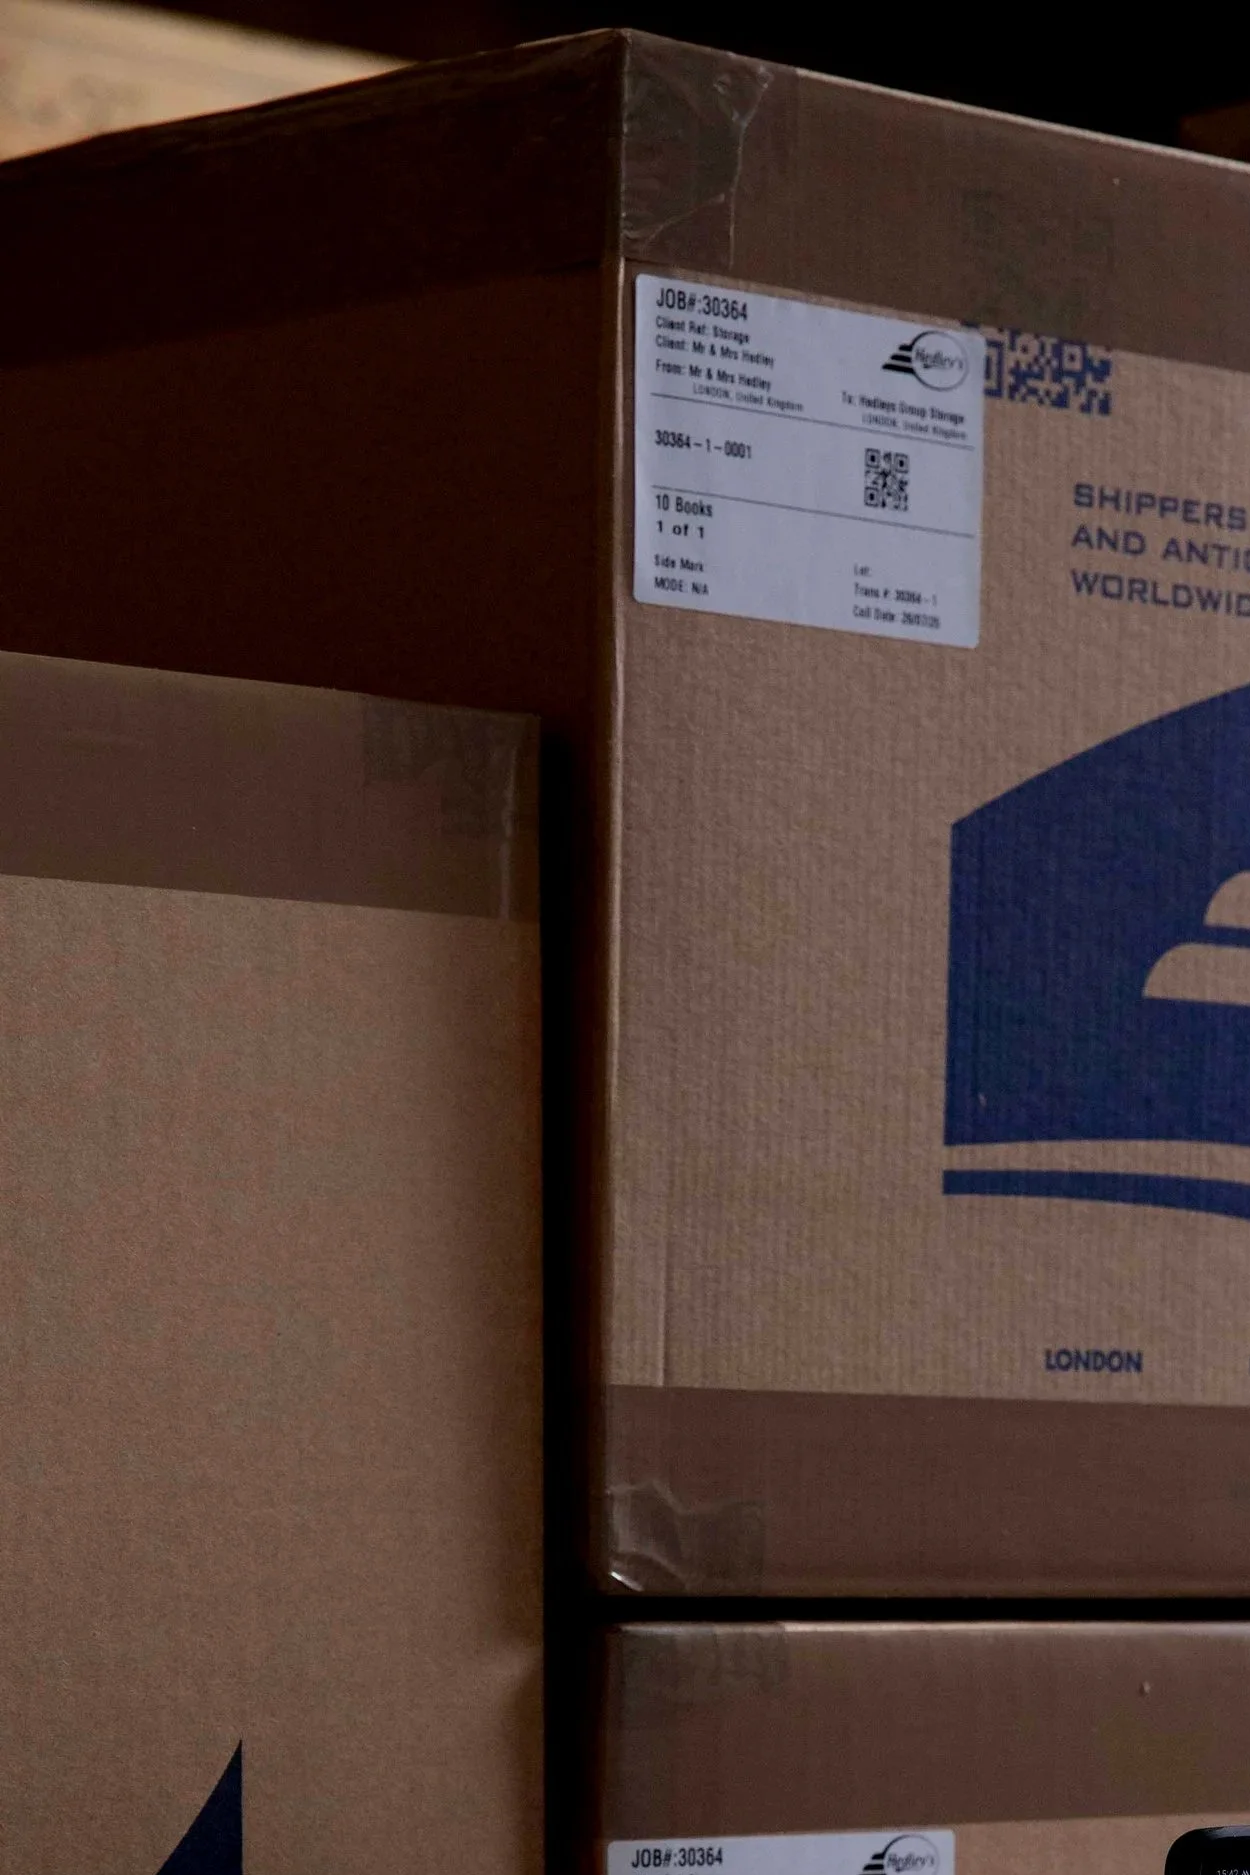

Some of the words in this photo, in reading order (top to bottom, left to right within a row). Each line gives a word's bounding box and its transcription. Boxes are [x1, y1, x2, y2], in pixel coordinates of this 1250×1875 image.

[656, 288, 748, 321] JOB#:30364
[655, 315, 685, 331] Client
[713, 325, 749, 345] Storage
[692, 341, 705, 354] Mr
[710, 344, 716, 356] &
[720, 345, 738, 361] Mrs
[742, 352, 774, 371] Hedley
[689, 364, 702, 377] Mr
[707, 368, 713, 380] &
[717, 369, 734, 384] Mrs
[738, 374, 771, 392] Hedley
[656, 494, 670, 511] 10
[676, 496, 713, 517] Books
[1073, 483, 1247, 532] SHIPPERS
[657, 520, 663, 533] 1
[672, 523, 689, 536] of
[698, 526, 704, 539] 1
[1070, 524, 1148, 556] AND
[654, 554, 676, 569] Side
[1045, 1349, 1143, 1373] LONDON
[631, 1847, 723, 1868] JOB#:30364
